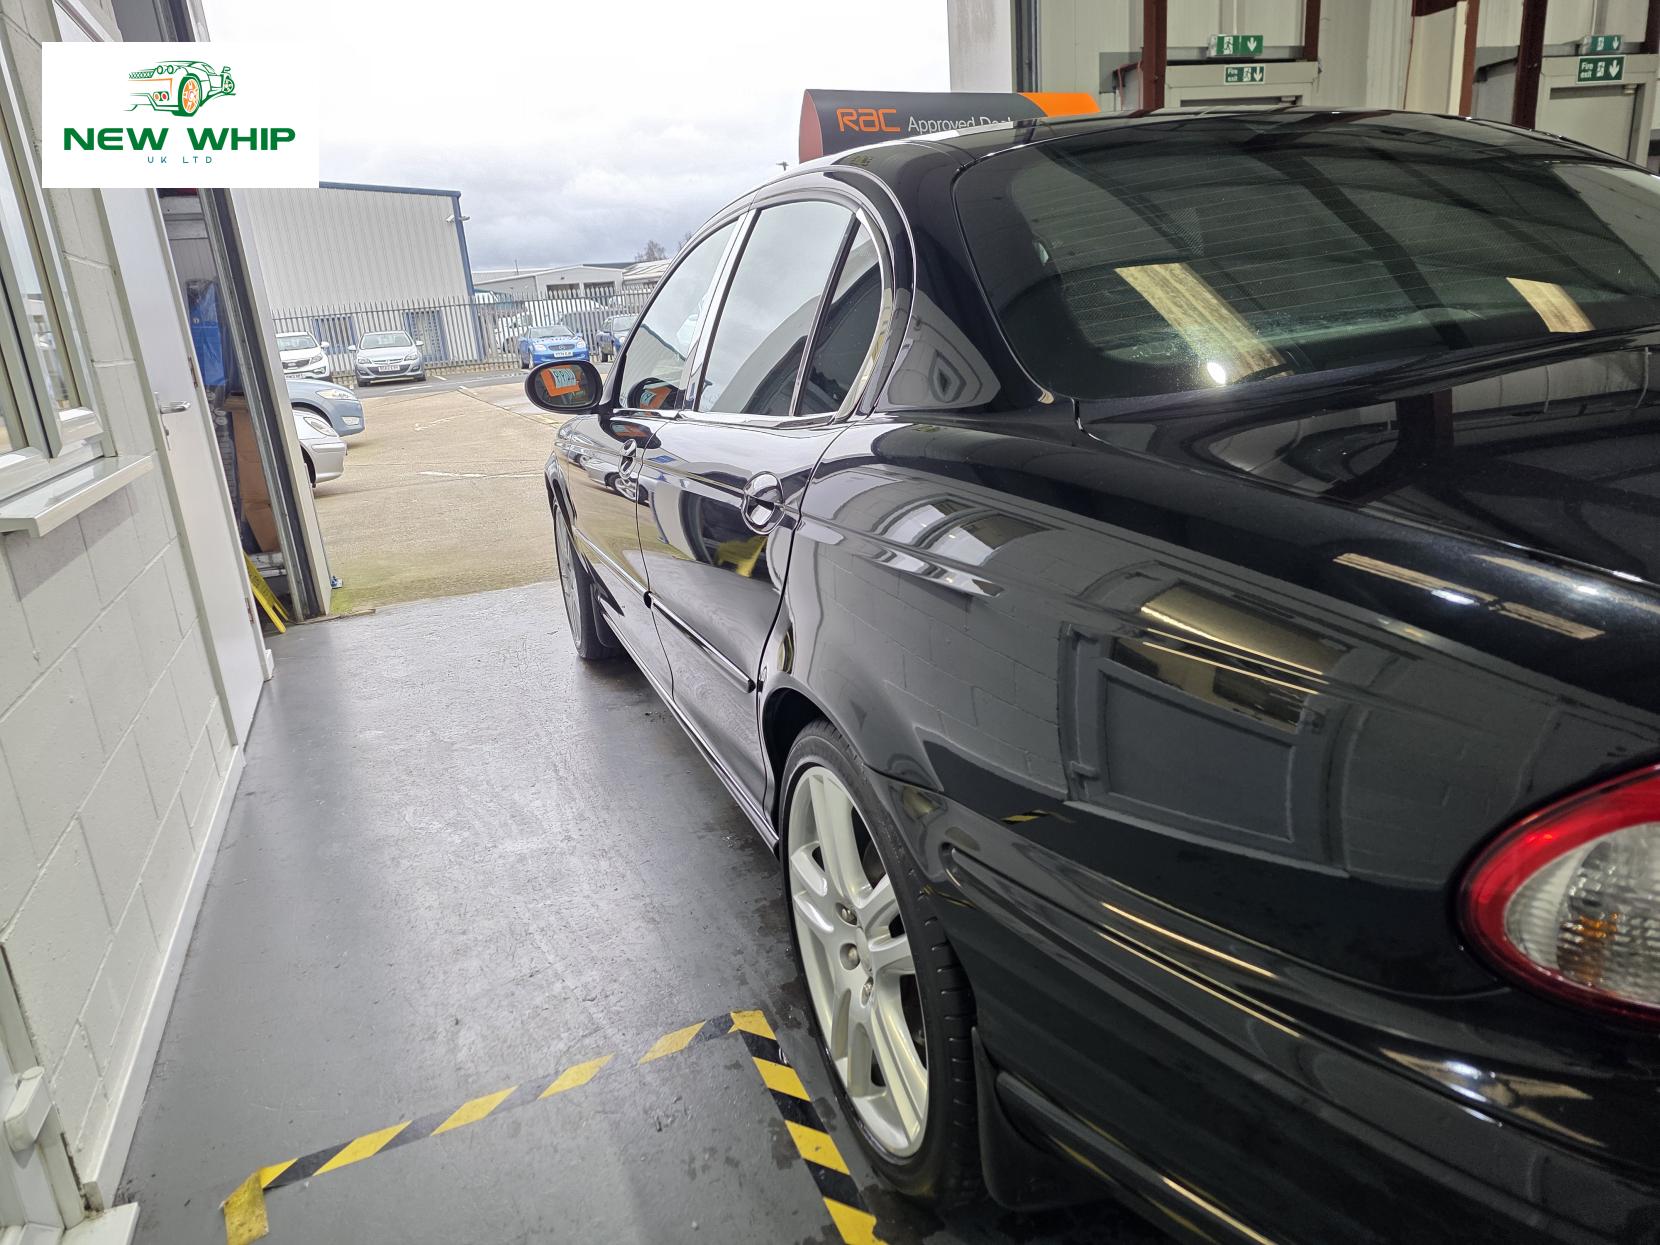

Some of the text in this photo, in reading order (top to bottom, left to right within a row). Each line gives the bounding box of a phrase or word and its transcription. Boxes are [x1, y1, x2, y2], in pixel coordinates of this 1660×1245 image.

[1581, 62, 1594, 70] Fire
[1580, 70, 1592, 78] exit
[908, 116, 975, 134] Approved
